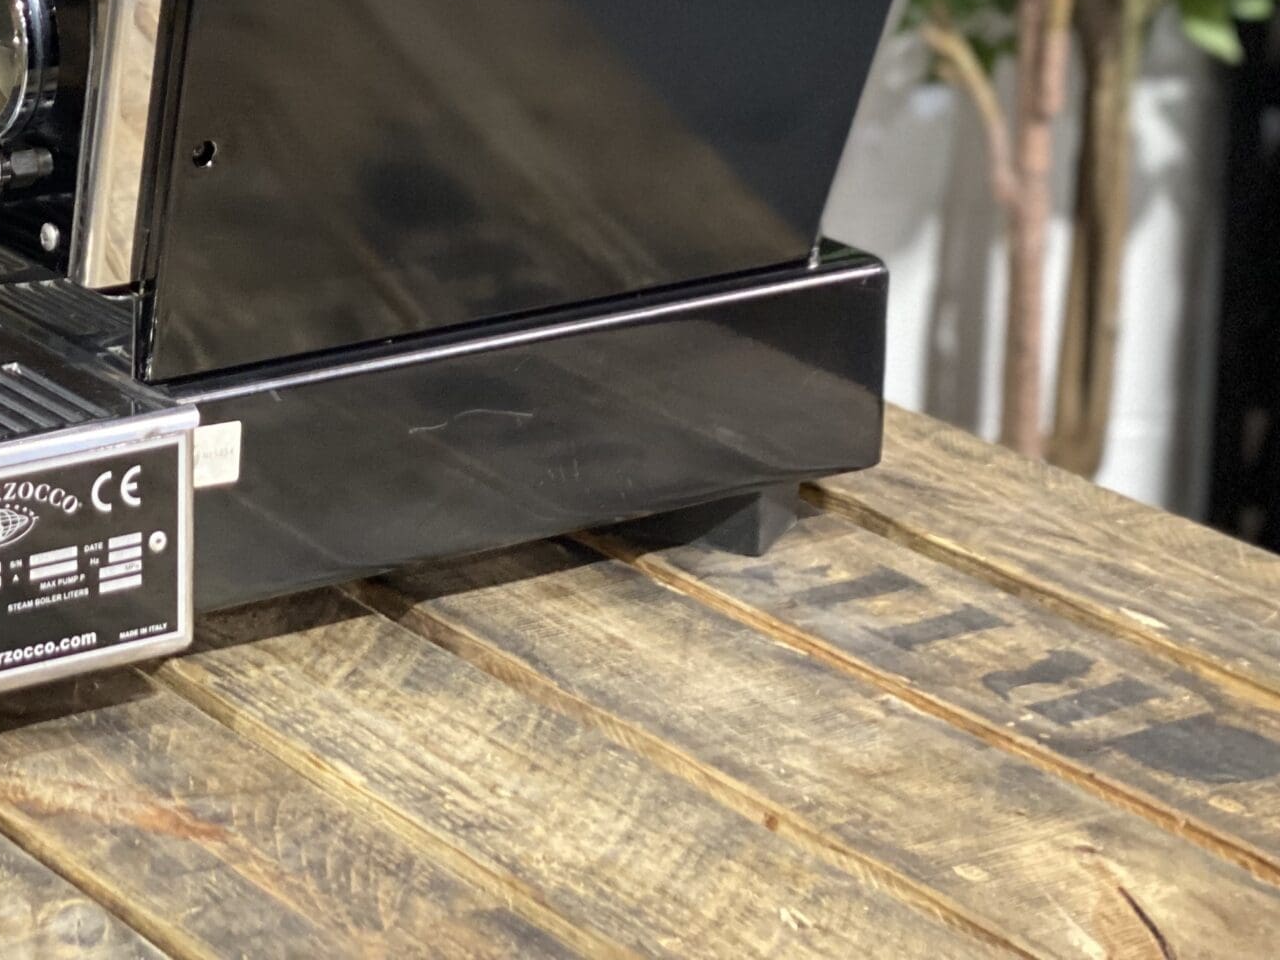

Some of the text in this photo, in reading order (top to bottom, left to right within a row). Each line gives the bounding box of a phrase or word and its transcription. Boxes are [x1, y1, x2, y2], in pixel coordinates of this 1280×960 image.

[91, 465, 141, 512] CE
[84, 542, 103, 553] DATE
[40, 579, 56, 590] MAX
[58, 575, 79, 587] PUMP
[8, 587, 90, 613] STEAM BOILER LITERS
[119, 623, 168, 639] MADE IN ITALY
